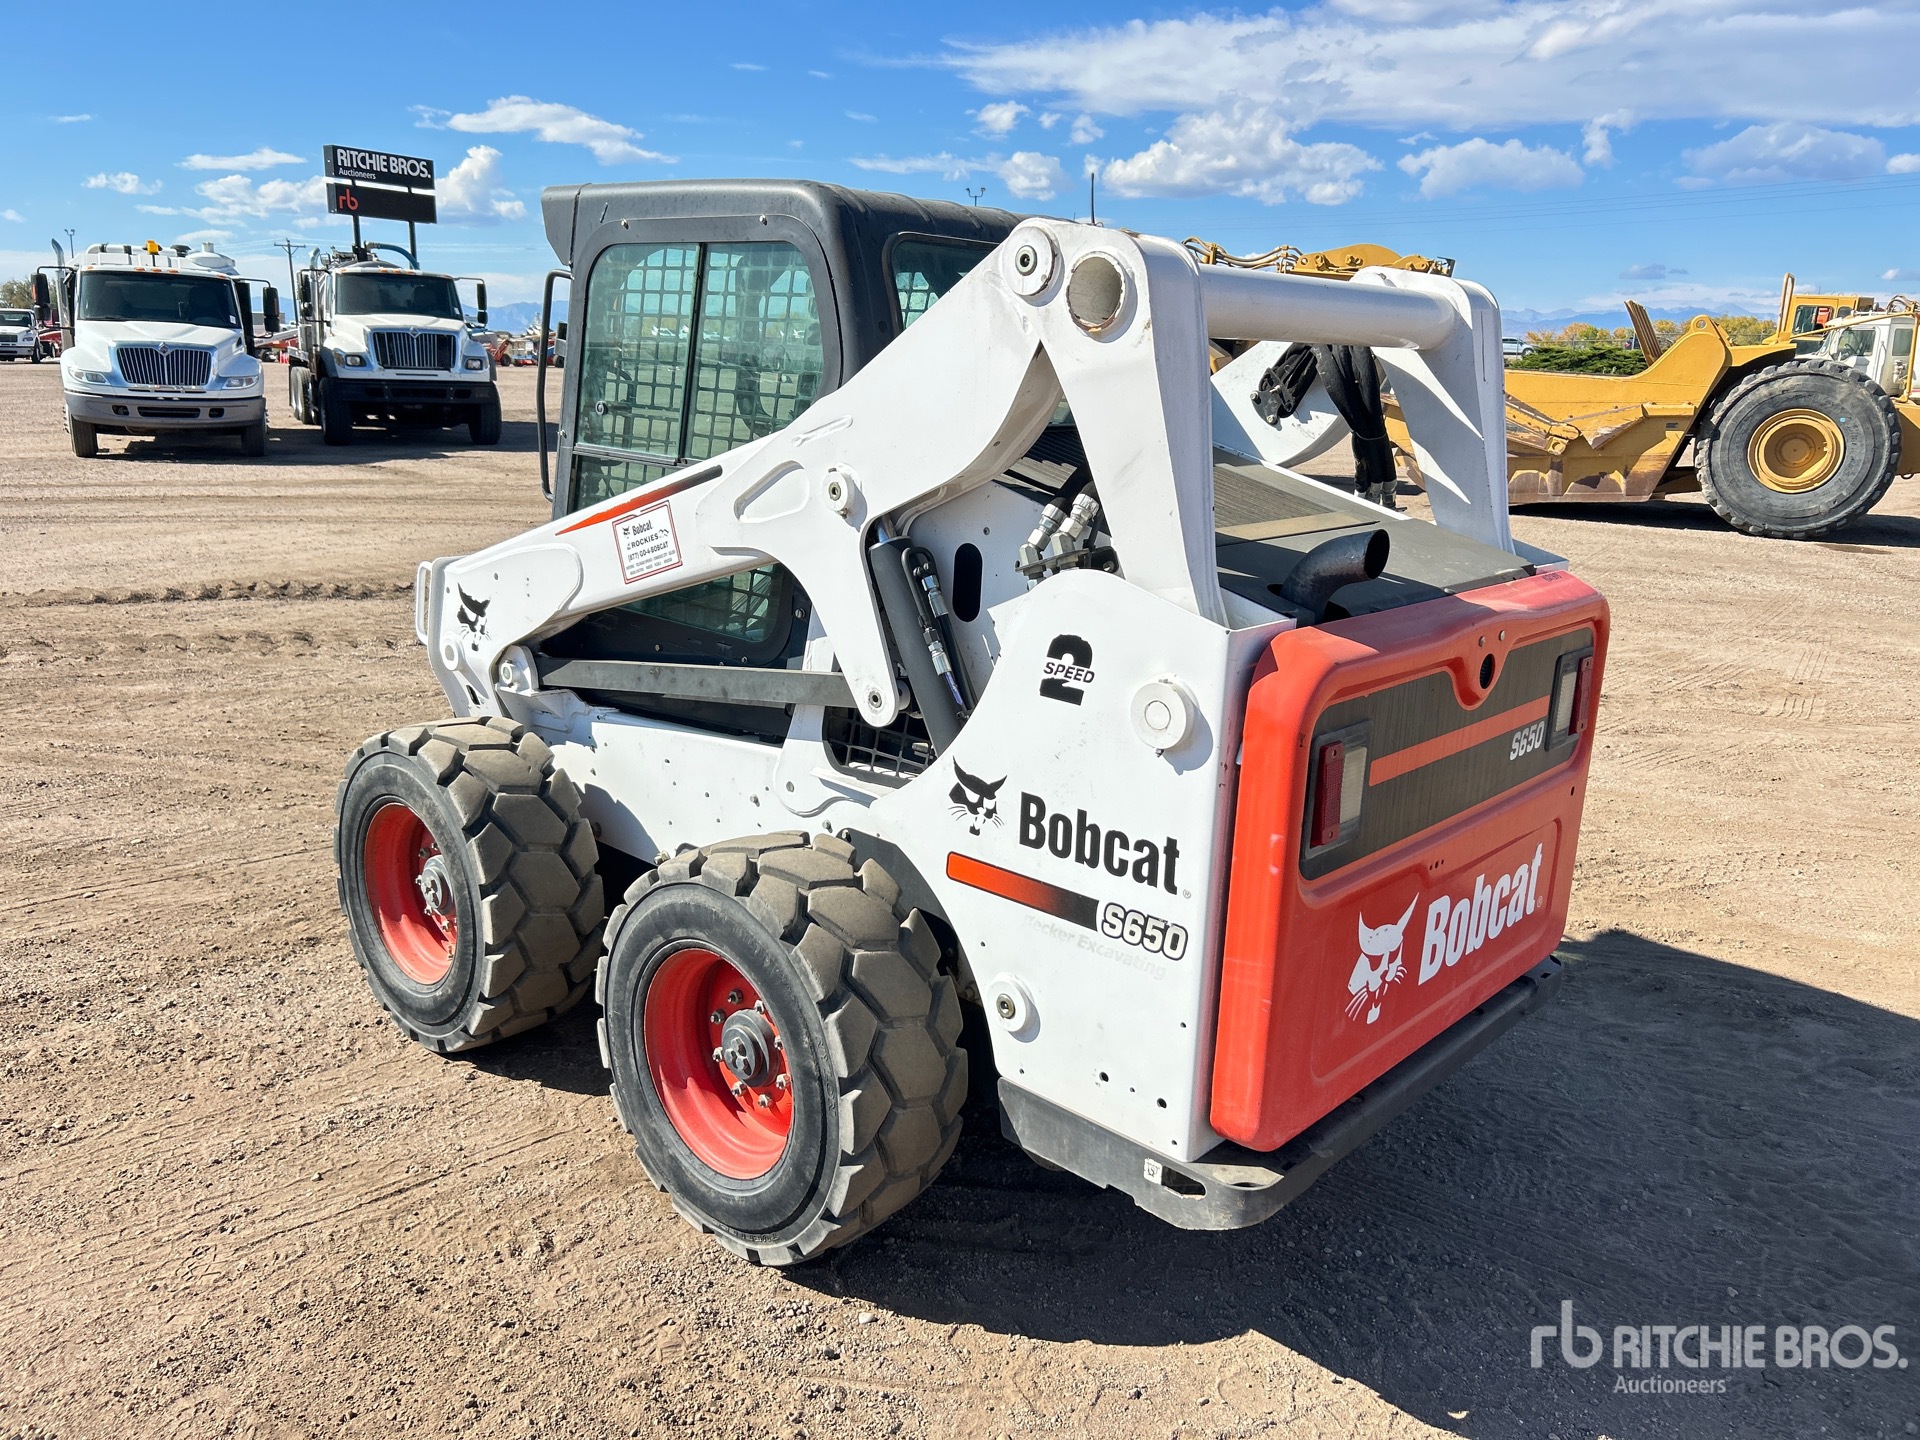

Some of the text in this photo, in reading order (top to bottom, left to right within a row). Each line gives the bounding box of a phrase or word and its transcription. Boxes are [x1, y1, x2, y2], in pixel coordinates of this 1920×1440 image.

[337, 148, 432, 179] RITCHIE BROS.
[339, 168, 376, 180] Auctioneers
[338, 188, 359, 211] rb
[631, 533, 659, 548] ROCKIES
[632, 520, 653, 536] Bobcat
[1039, 634, 1093, 706] 2
[1043, 662, 1095, 683] SPEED
[1509, 720, 1545, 761] S650
[1019, 791, 1180, 896] Bobcat
[1101, 902, 1189, 961] S650
[1418, 842, 1544, 986] Bobcat
[1076, 934, 1167, 981] Excavating
